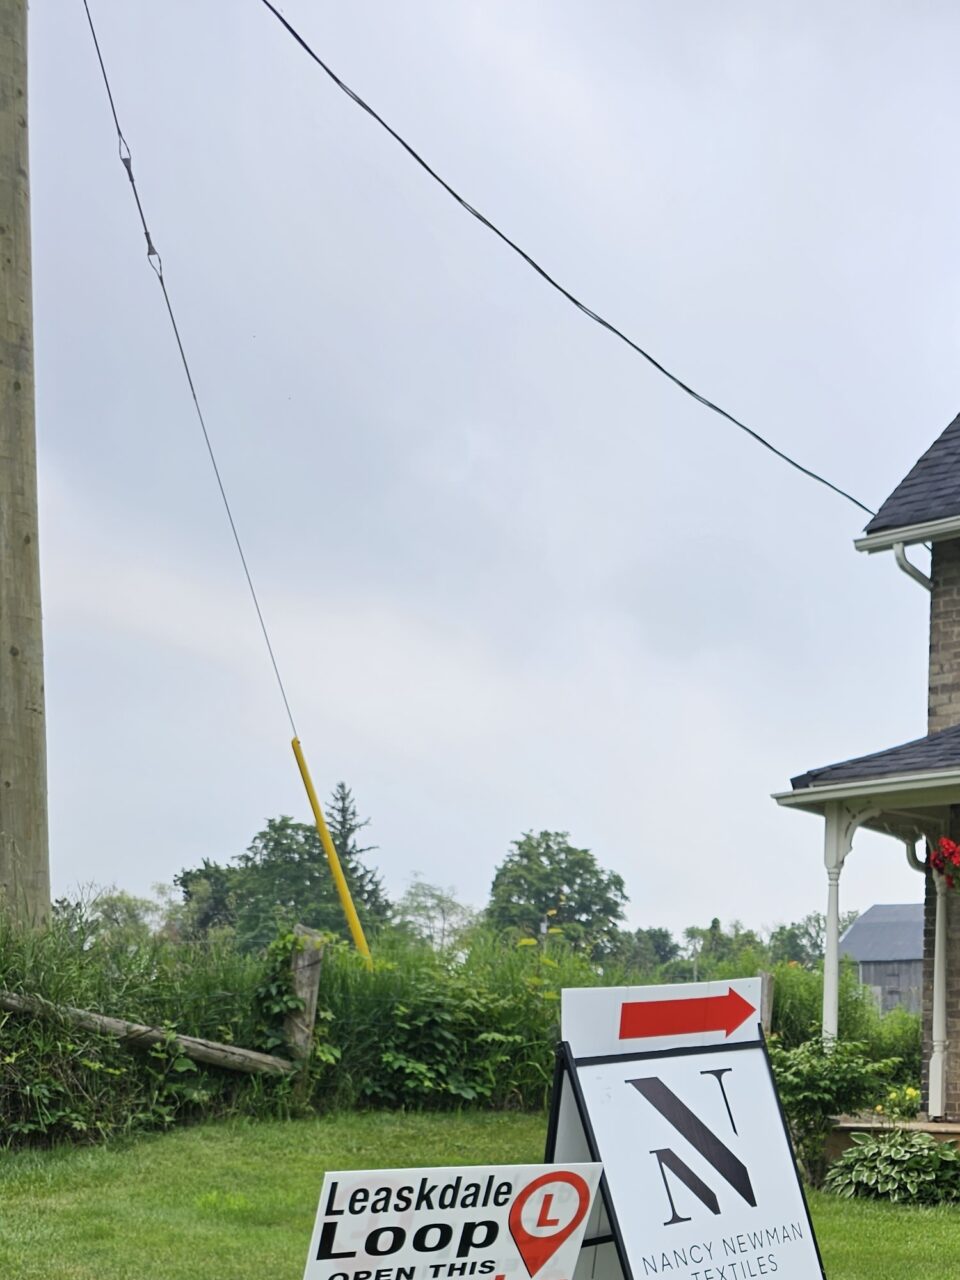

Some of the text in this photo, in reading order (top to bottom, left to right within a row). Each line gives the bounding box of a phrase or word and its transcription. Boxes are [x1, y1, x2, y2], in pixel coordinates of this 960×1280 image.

[325, 1175, 513, 1217] Leaskdale
[536, 1193, 560, 1228] L
[316, 1218, 500, 1261] Loop
[642, 1222, 804, 1276] NANCY NEWMAN
[429, 1259, 497, 1279] THIS
